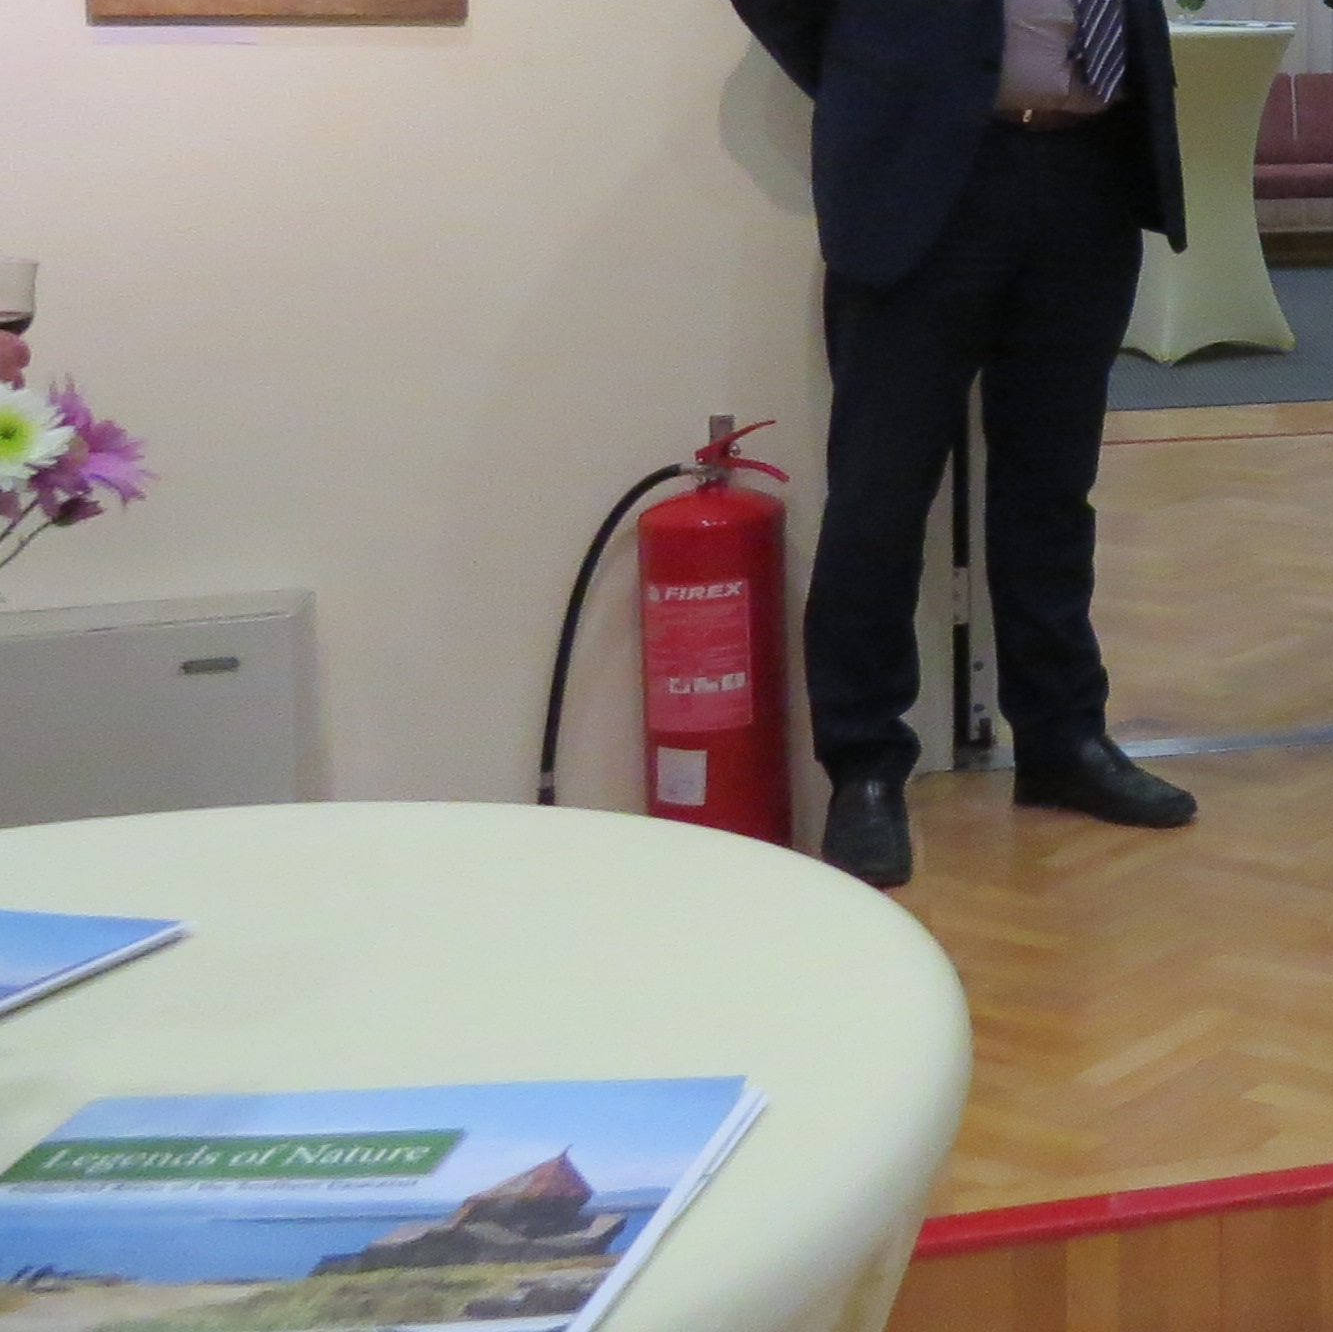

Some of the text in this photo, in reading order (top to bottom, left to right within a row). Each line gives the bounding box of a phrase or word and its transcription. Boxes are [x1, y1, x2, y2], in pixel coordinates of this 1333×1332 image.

[664, 581, 744, 601] FIREX
[40, 1143, 432, 1174] Legends of Nature
